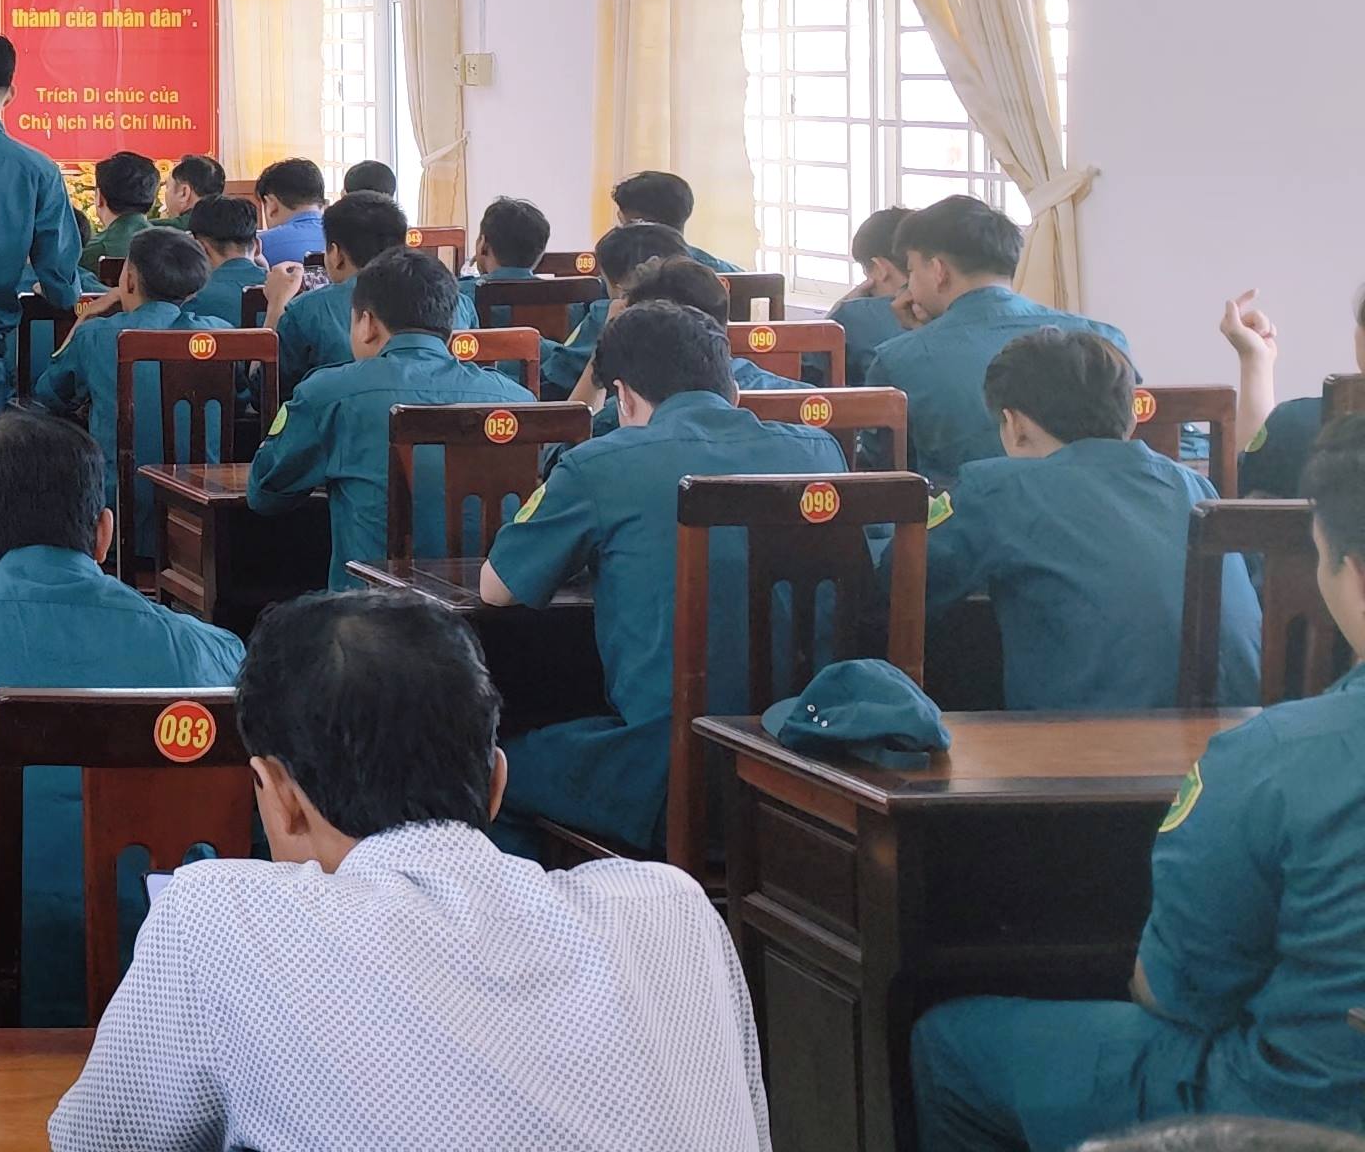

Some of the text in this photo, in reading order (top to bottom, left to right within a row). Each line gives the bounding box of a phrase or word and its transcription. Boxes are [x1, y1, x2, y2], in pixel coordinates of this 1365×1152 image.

[36, 86, 179, 104] Trích Di chúc của
[93, 112, 115, 130] Hồ
[120, 114, 148, 130] Chí
[152, 114, 196, 130] Minh.
[191, 339, 212, 353] 007
[454, 339, 475, 354] 094
[752, 332, 774, 346] 090
[804, 403, 829, 419] 099
[1134, 397, 1151, 414] 87
[489, 418, 514, 435] 052
[803, 490, 834, 514] 098
[160, 714, 209, 749] 083
